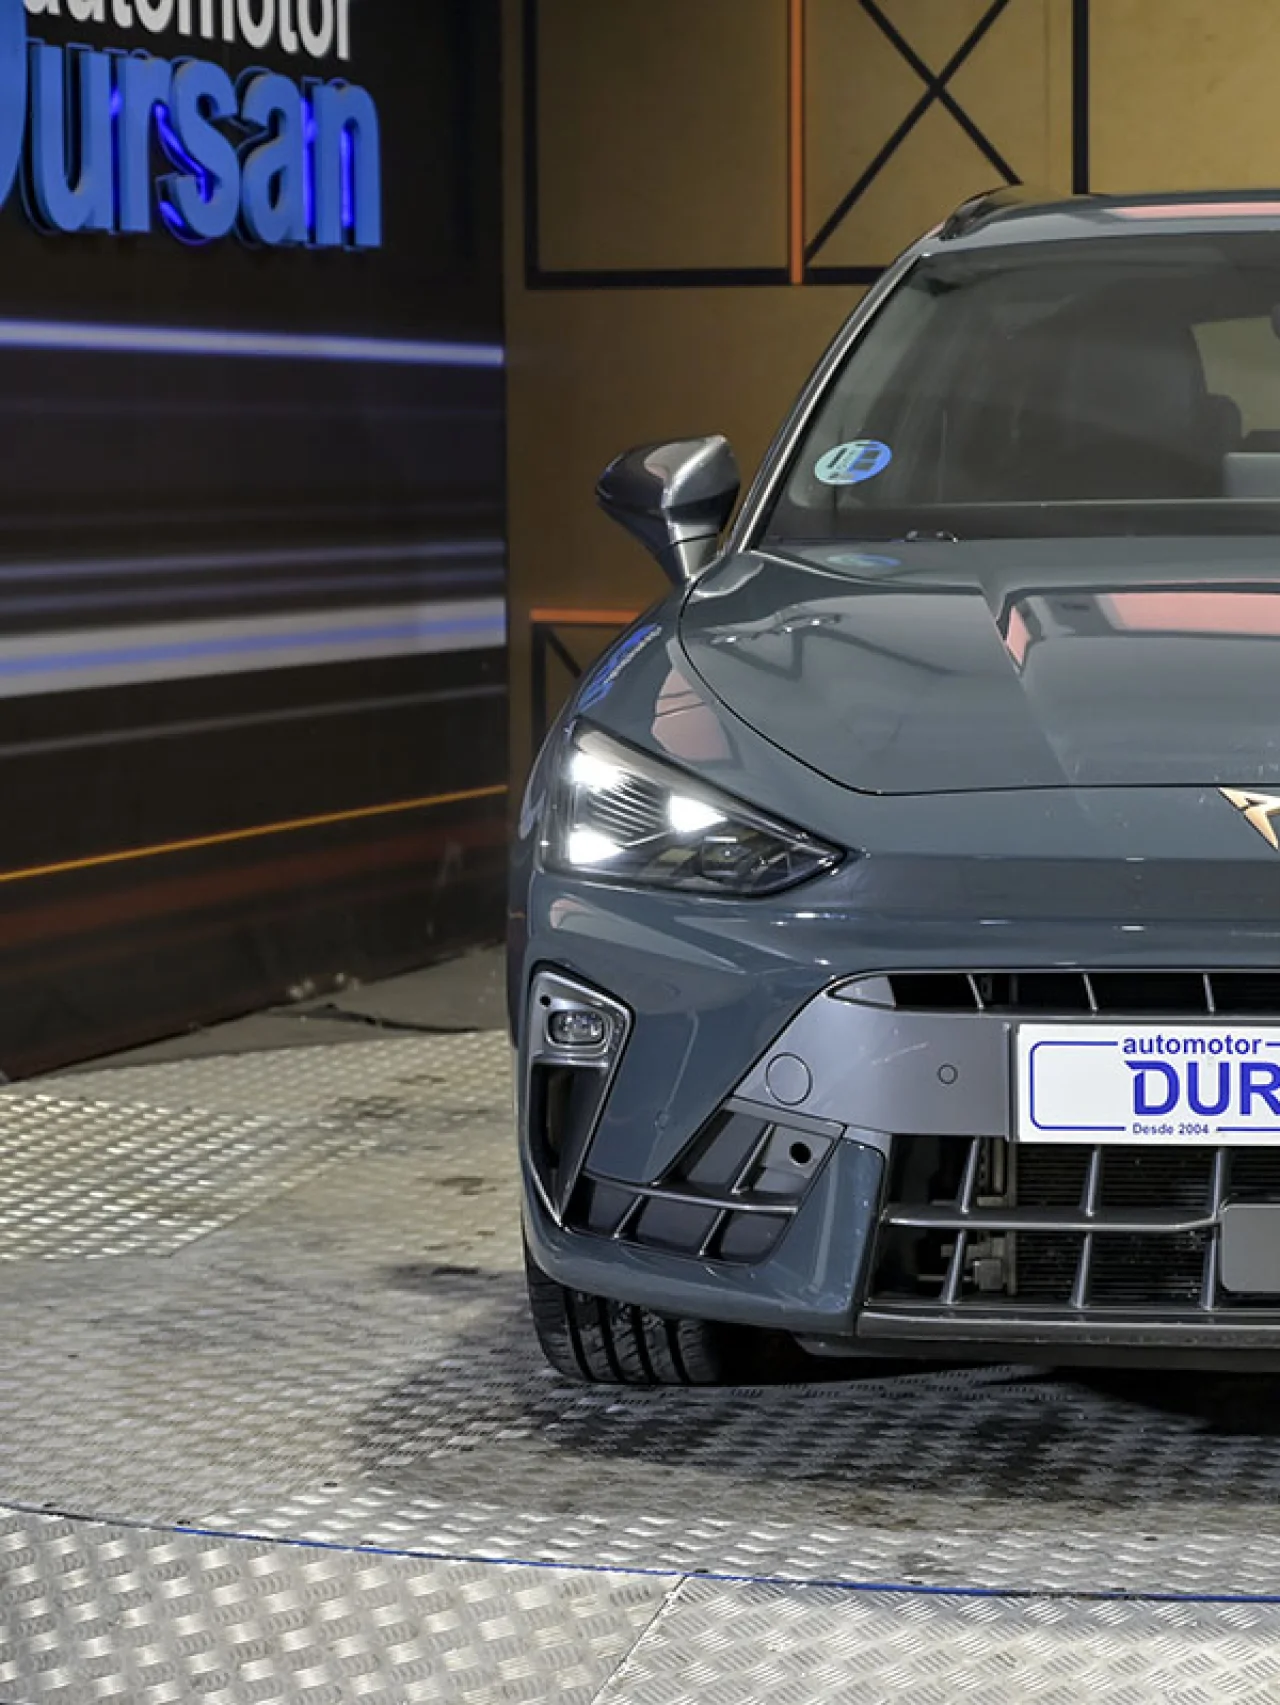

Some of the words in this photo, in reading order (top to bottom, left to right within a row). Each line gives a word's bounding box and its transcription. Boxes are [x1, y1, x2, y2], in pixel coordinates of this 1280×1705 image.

[1123, 1034, 1262, 1055] automotor
[1132, 1122, 1174, 1135] Desde
[1179, 1122, 1210, 1135] 2004
